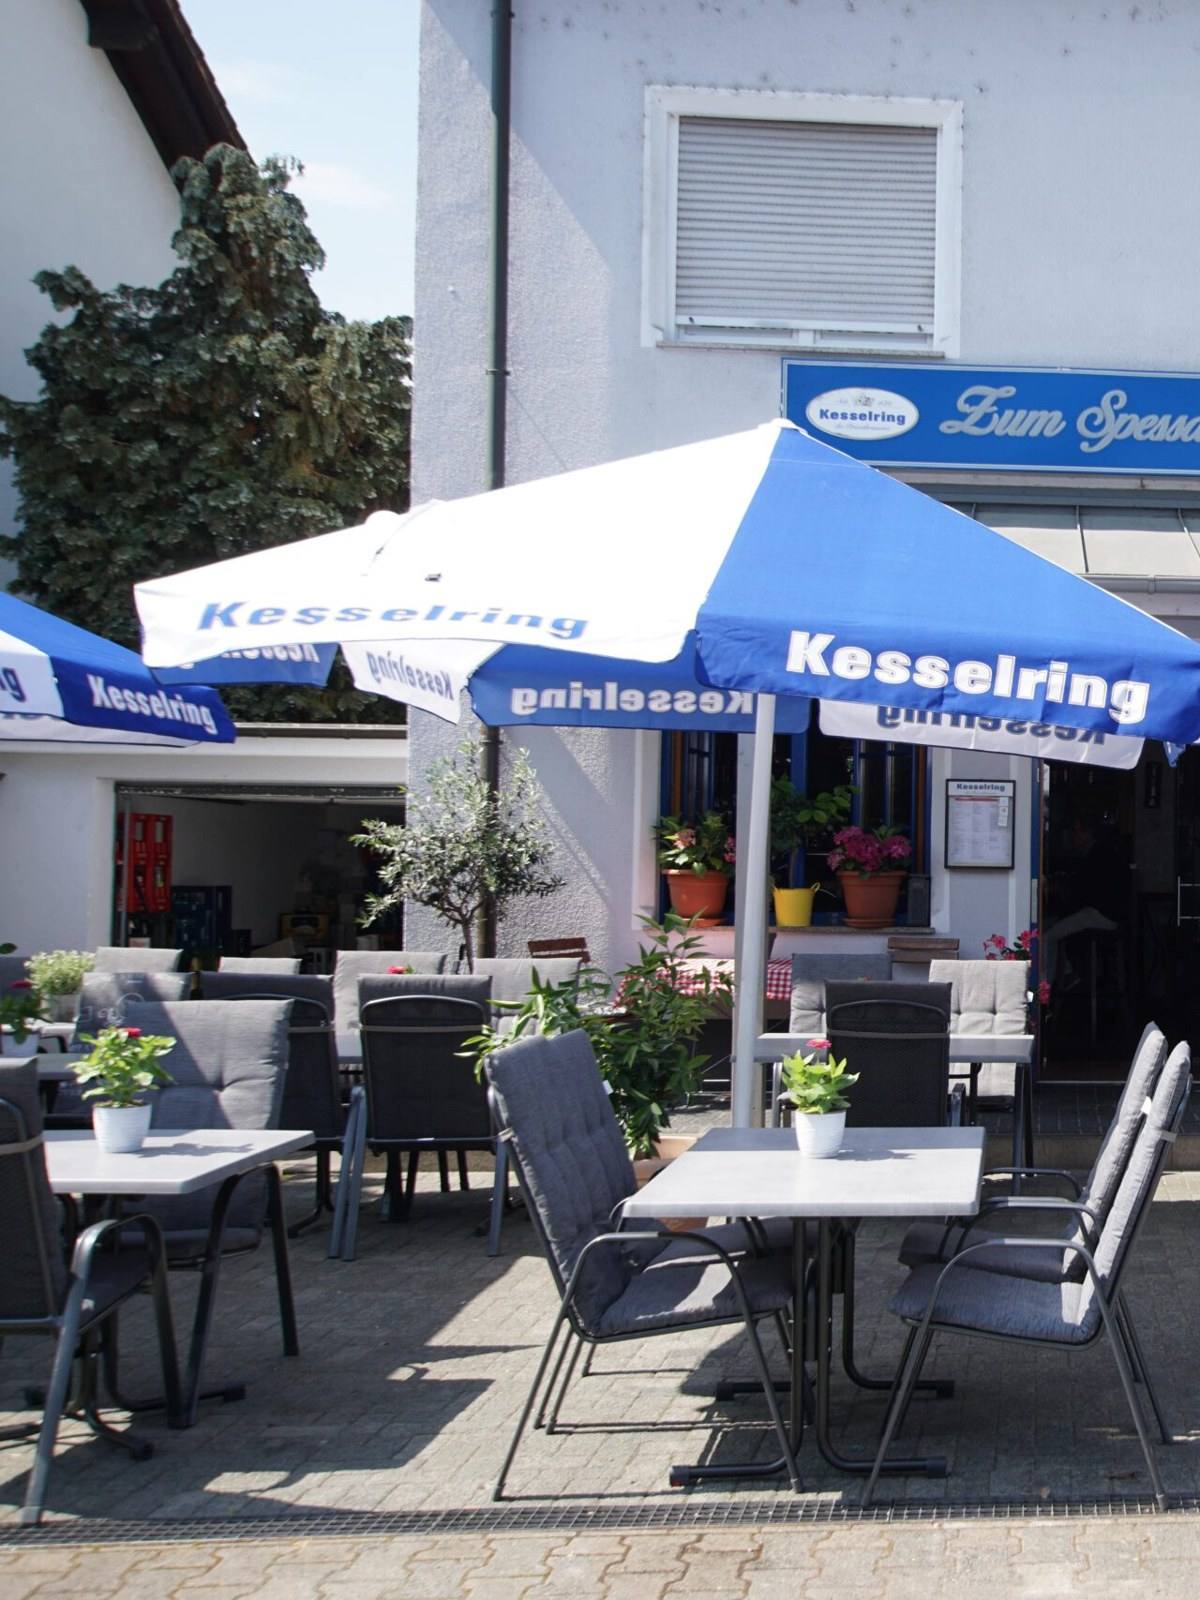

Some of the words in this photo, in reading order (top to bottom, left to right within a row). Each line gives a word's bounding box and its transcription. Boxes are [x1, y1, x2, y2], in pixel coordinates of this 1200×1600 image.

[819, 408, 906, 425] Kesselring
[939, 385, 1067, 437] Zum
[198, 601, 589, 640] Kesselring
[785, 629, 1151, 725] Kesselring
[86, 673, 218, 735] Kesselring
[956, 783, 1005, 792] Kesselring
